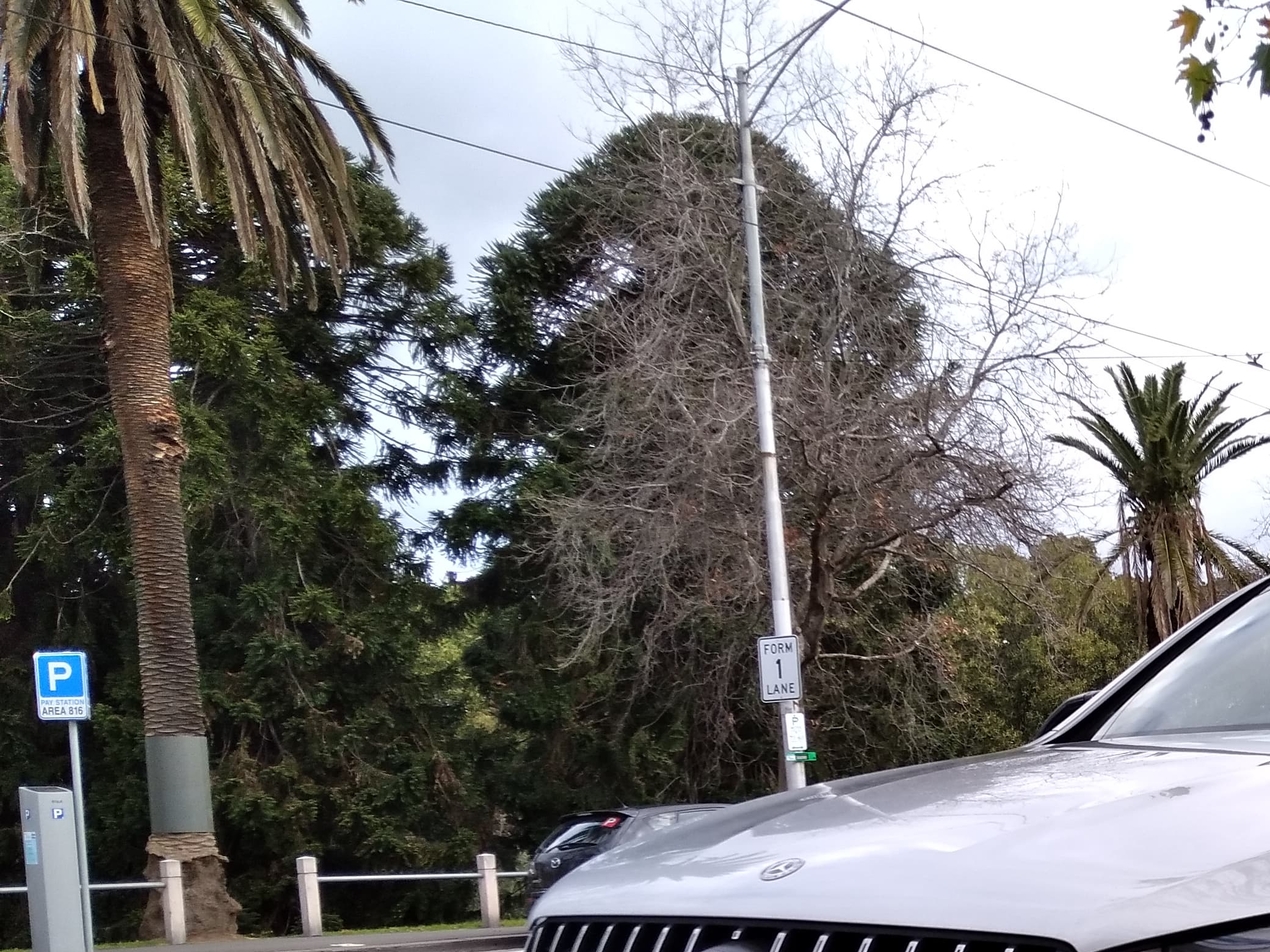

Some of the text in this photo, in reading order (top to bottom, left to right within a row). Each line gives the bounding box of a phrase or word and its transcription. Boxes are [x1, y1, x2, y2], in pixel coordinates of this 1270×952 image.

[764, 643, 793, 655] FORM
[775, 659, 783, 679] 1
[47, 661, 72, 692] P
[766, 683, 795, 695] LANE
[42, 706, 84, 715] AREA 816
